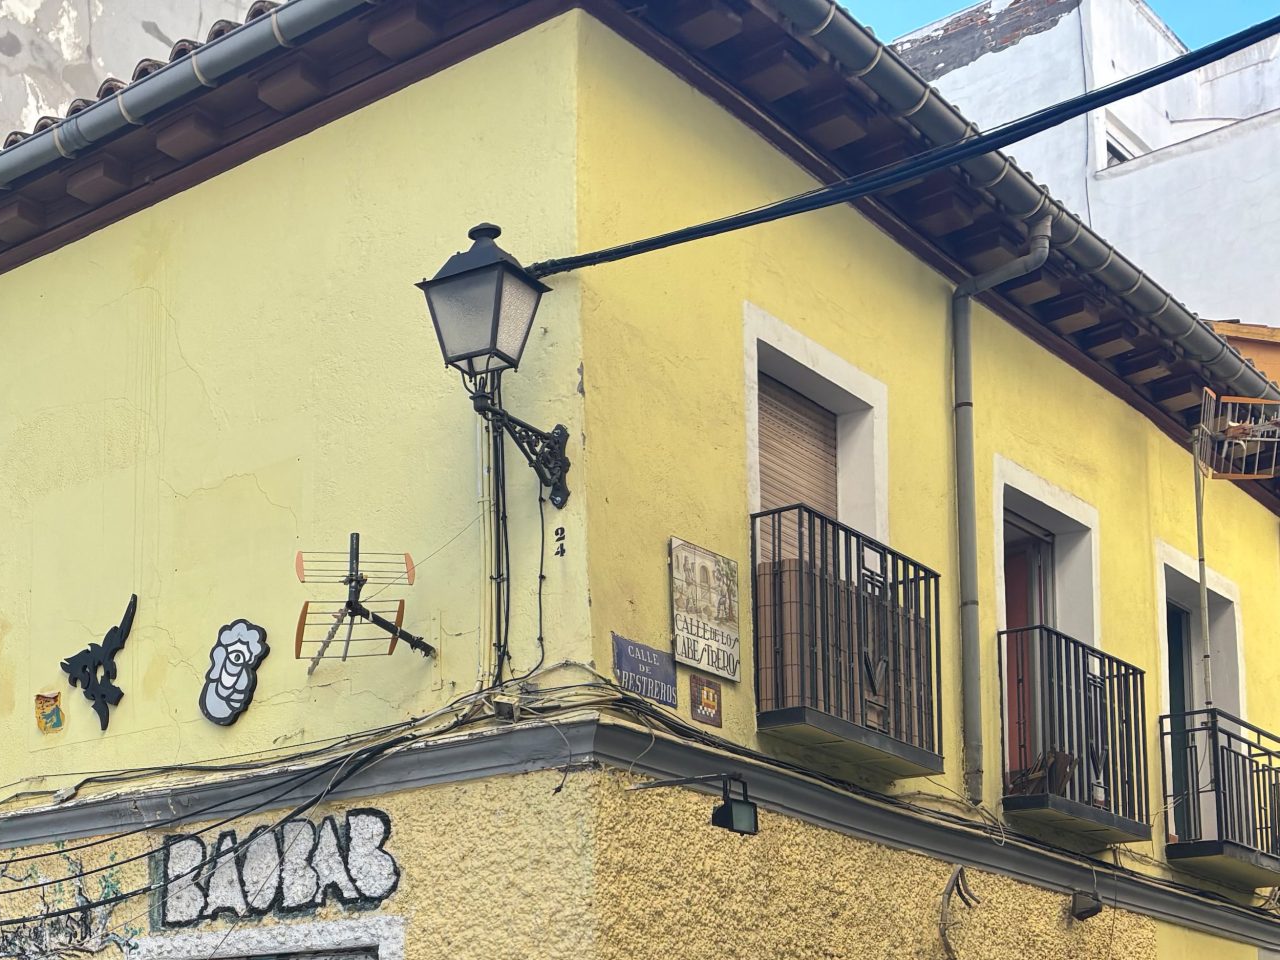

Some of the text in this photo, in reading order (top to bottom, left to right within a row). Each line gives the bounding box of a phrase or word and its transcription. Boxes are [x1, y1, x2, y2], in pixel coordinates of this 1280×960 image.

[554, 526, 566, 558] 24
[675, 613, 739, 649] CALLE DE LOS
[628, 645, 659, 665] CALLE
[639, 663, 652, 674] DE
[675, 633, 740, 677] CABESTREROS
[161, 807, 401, 927] BAOBAB
